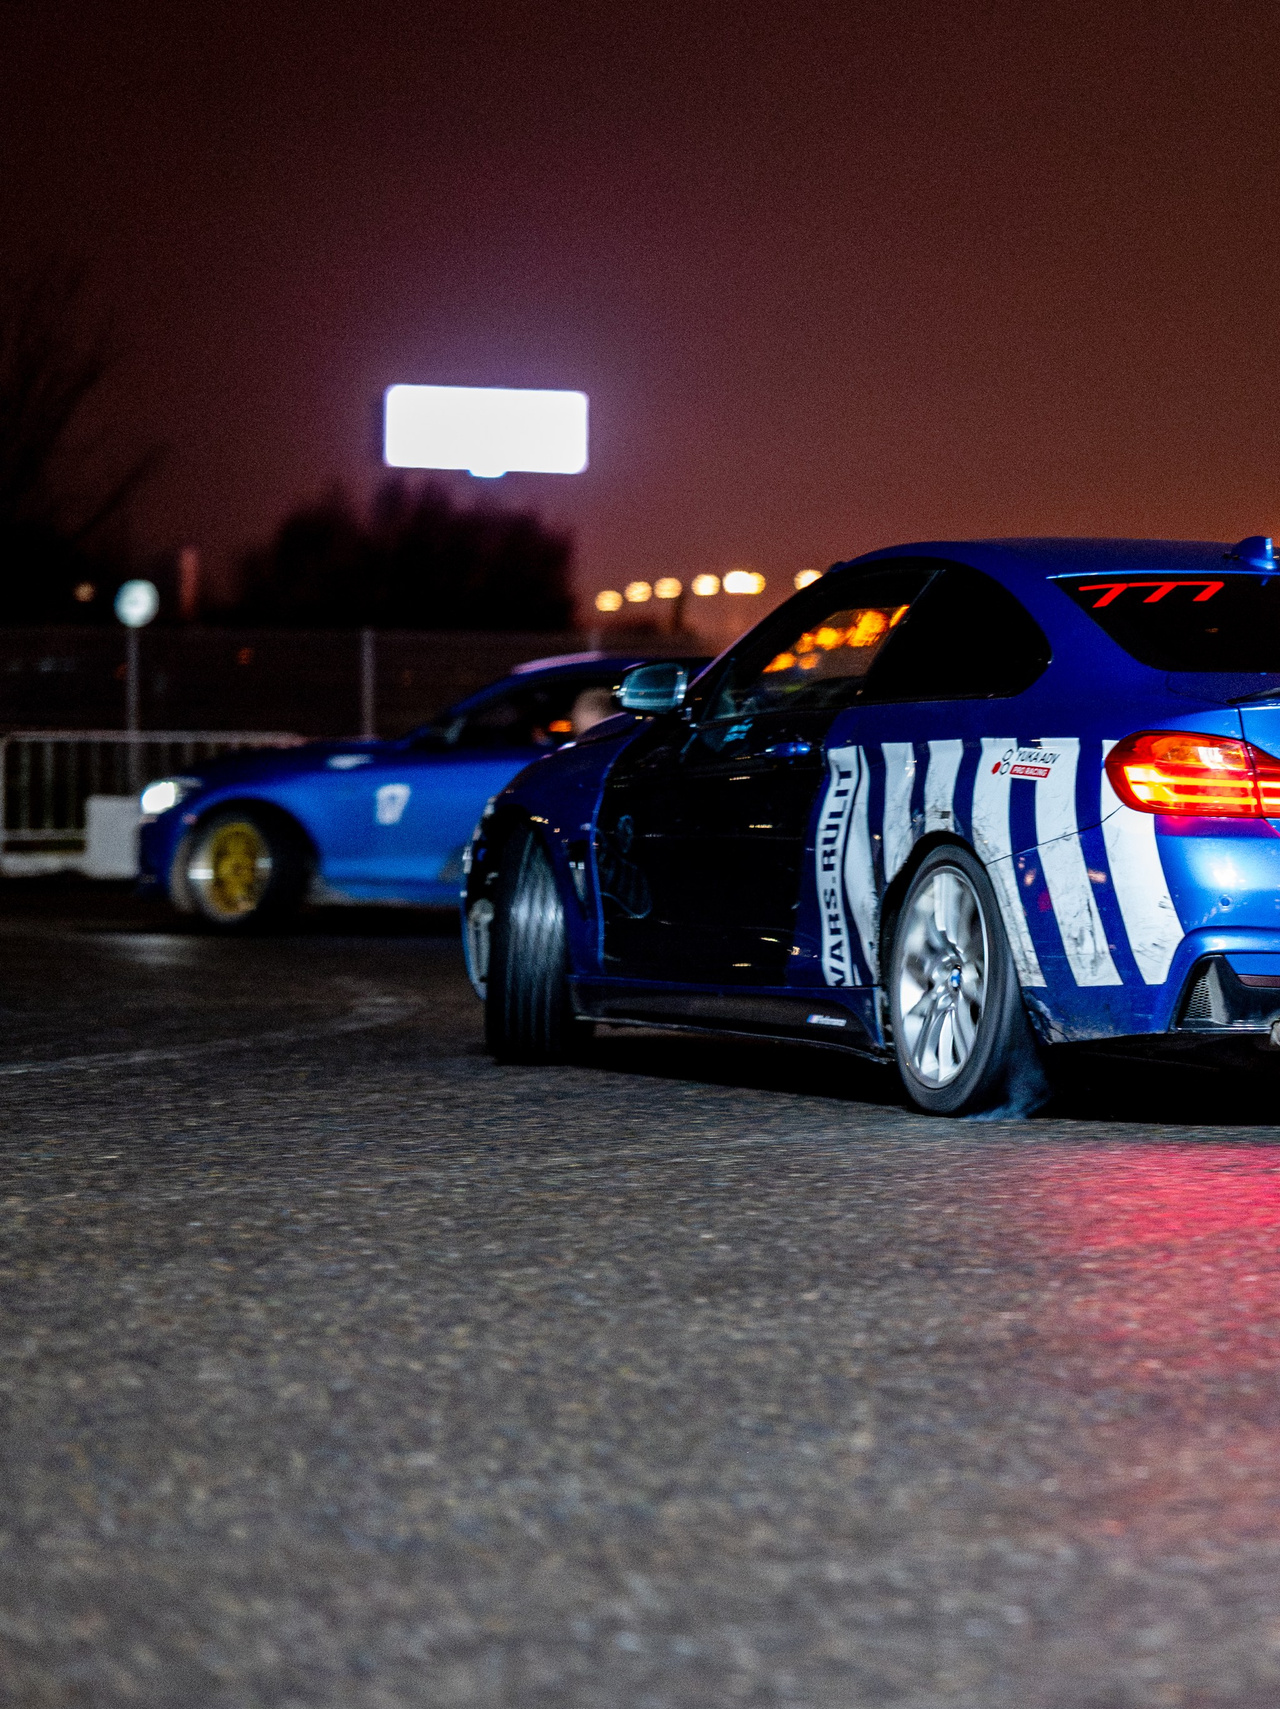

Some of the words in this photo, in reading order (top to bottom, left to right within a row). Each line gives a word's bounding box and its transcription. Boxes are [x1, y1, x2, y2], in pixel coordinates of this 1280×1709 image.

[1078, 581, 1225, 608] 777
[1012, 766, 1026, 774] PRO
[1025, 767, 1048, 777] RACING
[822, 764, 853, 986] VARS.RULIT
